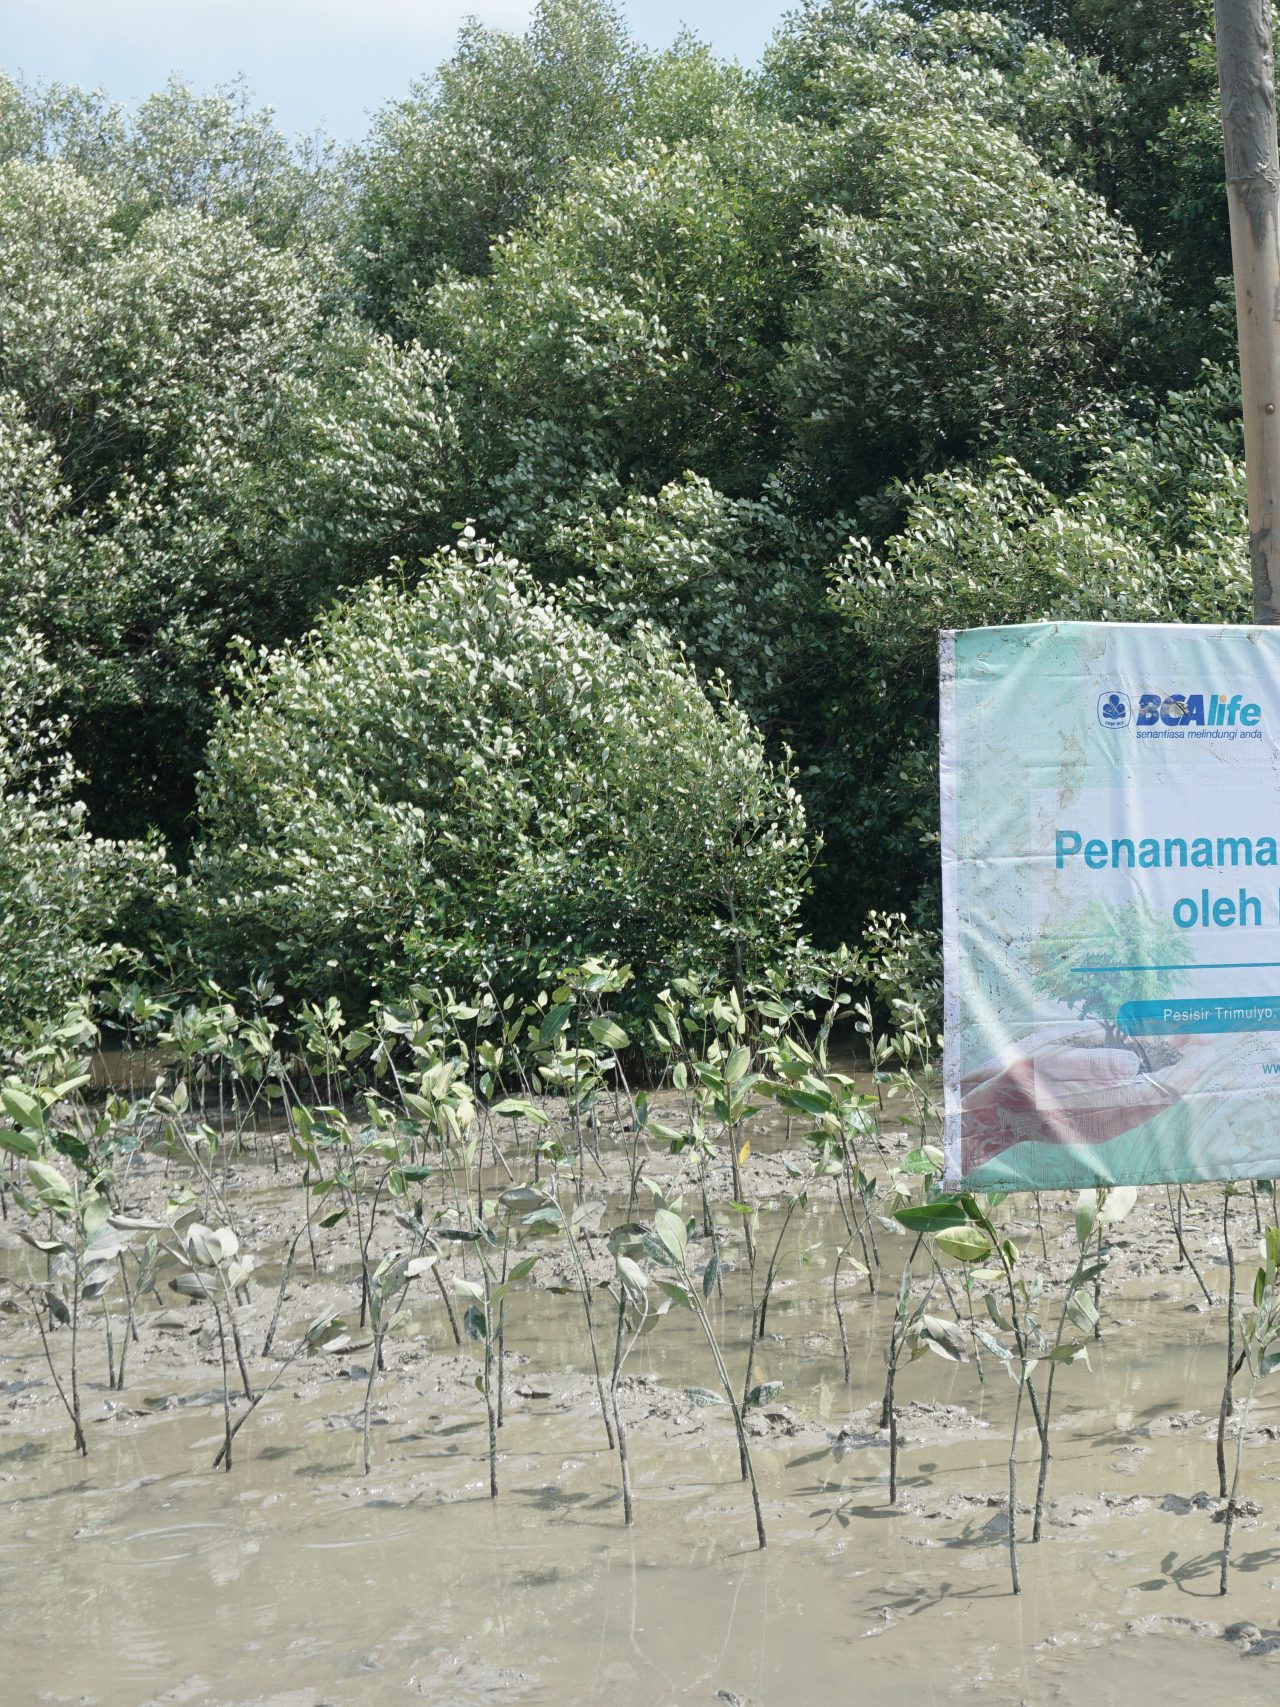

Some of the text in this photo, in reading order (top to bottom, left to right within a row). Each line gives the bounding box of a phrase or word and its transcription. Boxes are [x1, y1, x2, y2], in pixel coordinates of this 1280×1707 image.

[1136, 728, 1263, 741] senantiasa melindungi anda
[1173, 888, 1262, 929] oleh
[1163, 1007, 1210, 1022] Pesisir
[1214, 1005, 1277, 1022] Trimulyo,
